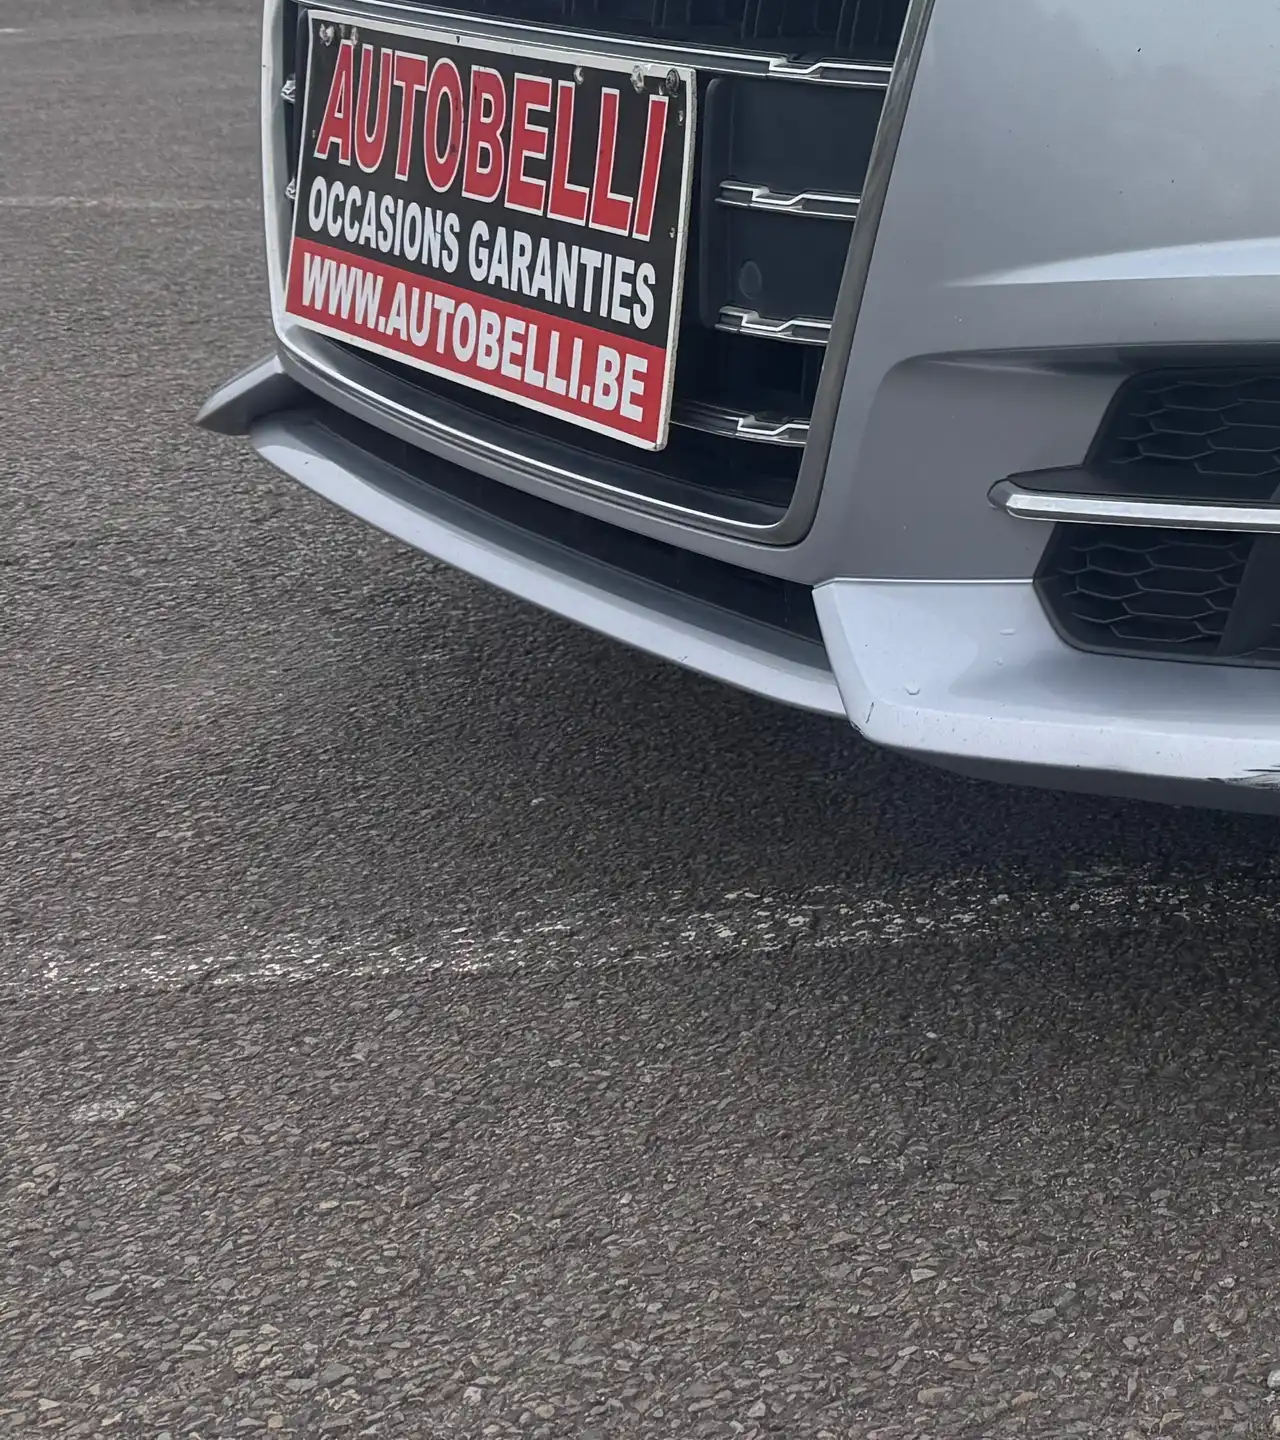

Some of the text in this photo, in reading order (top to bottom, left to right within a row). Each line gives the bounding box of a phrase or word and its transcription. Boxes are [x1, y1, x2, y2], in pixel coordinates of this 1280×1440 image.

[313, 39, 670, 242] AUTOBELLI
[302, 251, 649, 423] WWW.AUTOBELLI.BE
[308, 175, 656, 330] OCCASIONS GARANTIES
